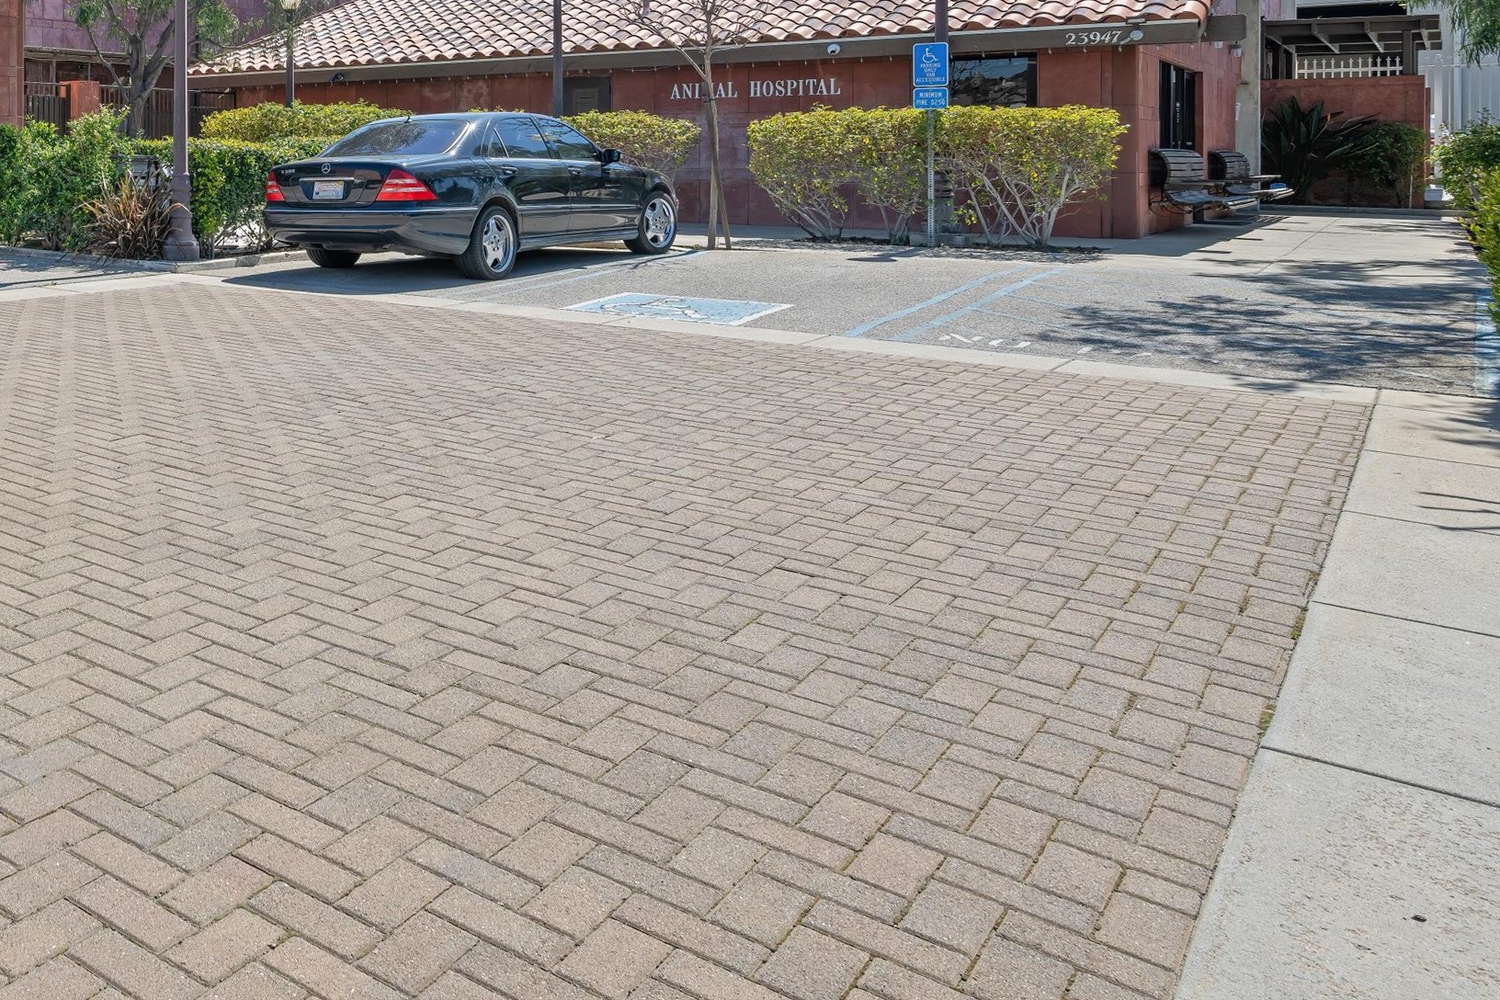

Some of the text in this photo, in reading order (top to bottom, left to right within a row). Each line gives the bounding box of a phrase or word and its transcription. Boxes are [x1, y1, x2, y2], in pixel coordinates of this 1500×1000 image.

[1065, 30, 1123, 46] 23947
[670, 77, 841, 100] ANIAL HOSPITAL
